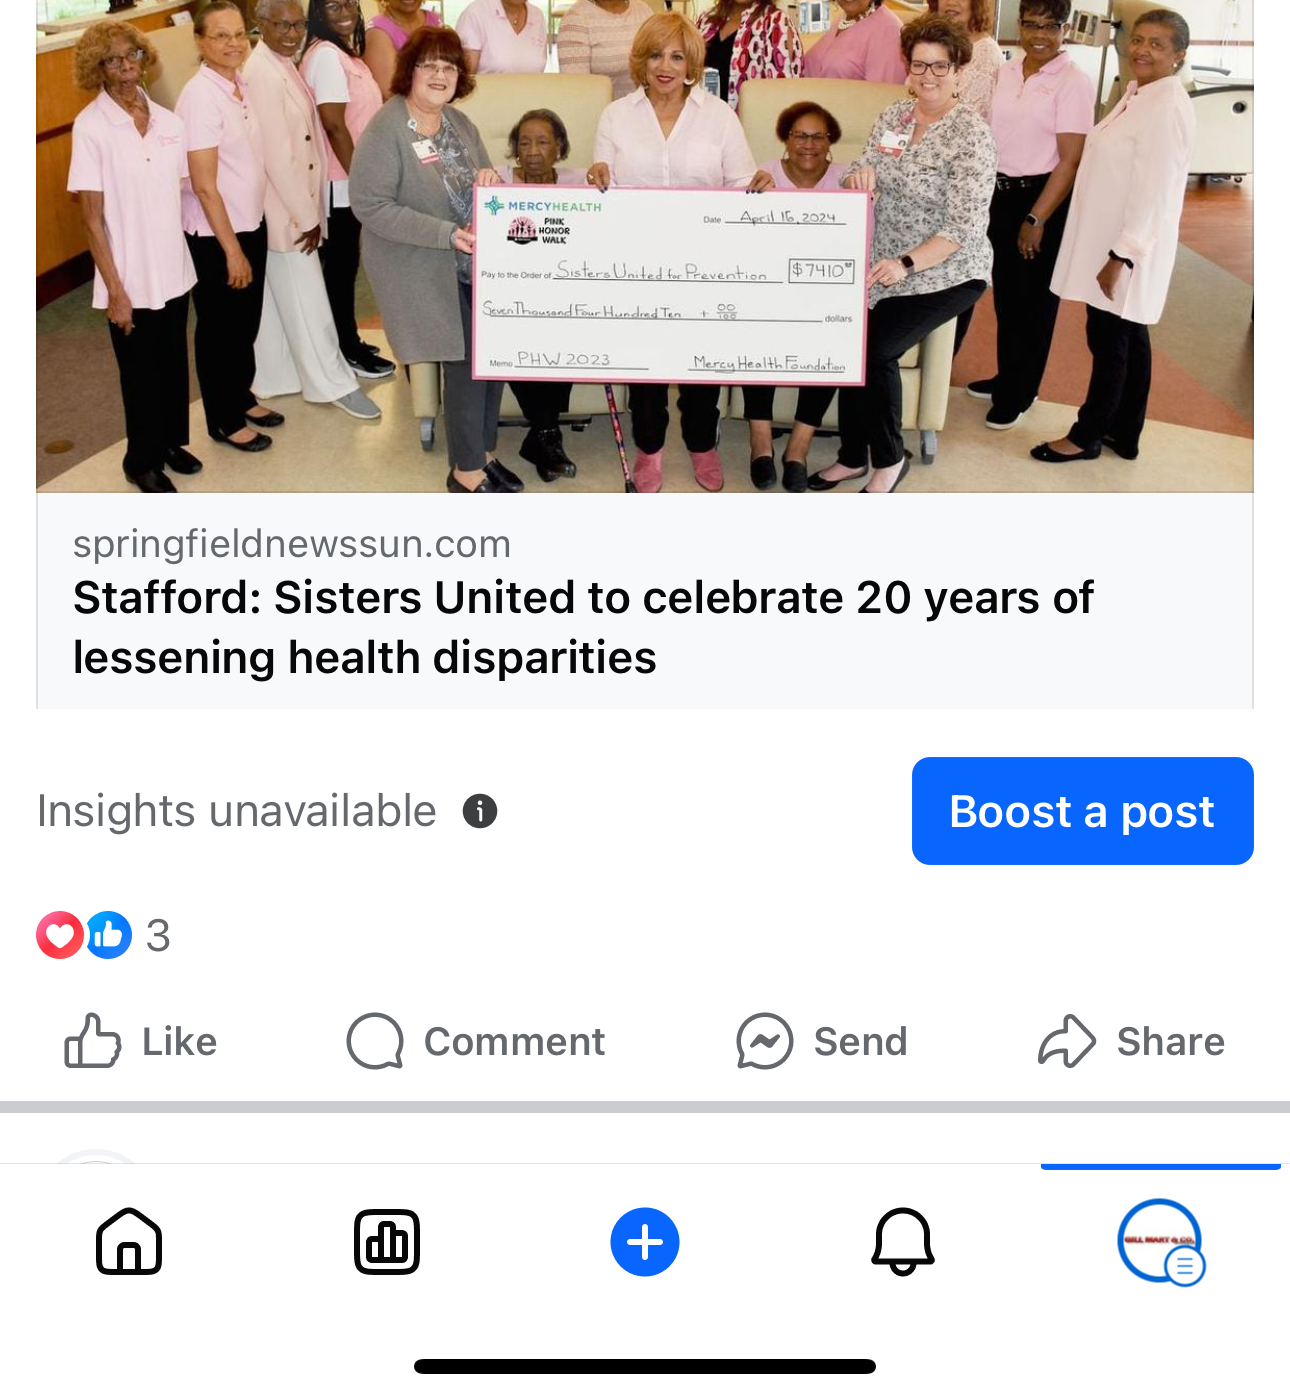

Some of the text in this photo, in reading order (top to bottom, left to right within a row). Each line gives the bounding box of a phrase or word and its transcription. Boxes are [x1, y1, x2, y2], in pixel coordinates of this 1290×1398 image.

[544, 217, 565, 226] PINK
[703, 215, 722, 224] Date
[740, 209, 775, 227] April
[801, 212, 836, 223] 2024
[538, 226, 571, 235] HONOR
[542, 235, 567, 245] WALK
[481, 271, 552, 280] Pay to the Order of
[555, 259, 767, 281] Sisters United for Prevention
[482, 300, 514, 317] Seven
[513, 301, 573, 317] Thousand
[574, 303, 600, 317] Four
[603, 305, 659, 319] Hundred
[659, 307, 682, 319] Ten
[824, 315, 853, 323] dollars
[489, 359, 513, 368] Memo
[517, 351, 610, 366] PHW 2023
[693, 355, 846, 373] Mercy Health Foundation
[73, 527, 510, 565] springfieldnewssun.com
[73, 577, 1095, 623] Stafford: Sisters United to celebrate 20 years of
[74, 637, 657, 683] lessening health disparities
[39, 791, 437, 836] Insights unavailable
[951, 794, 1215, 836] Boost a post
[146, 918, 170, 953] 3
[143, 1024, 217, 1057] Like
[424, 1026, 606, 1057] Comment
[814, 1025, 907, 1057] Send
[1117, 1025, 1225, 1057] Share
